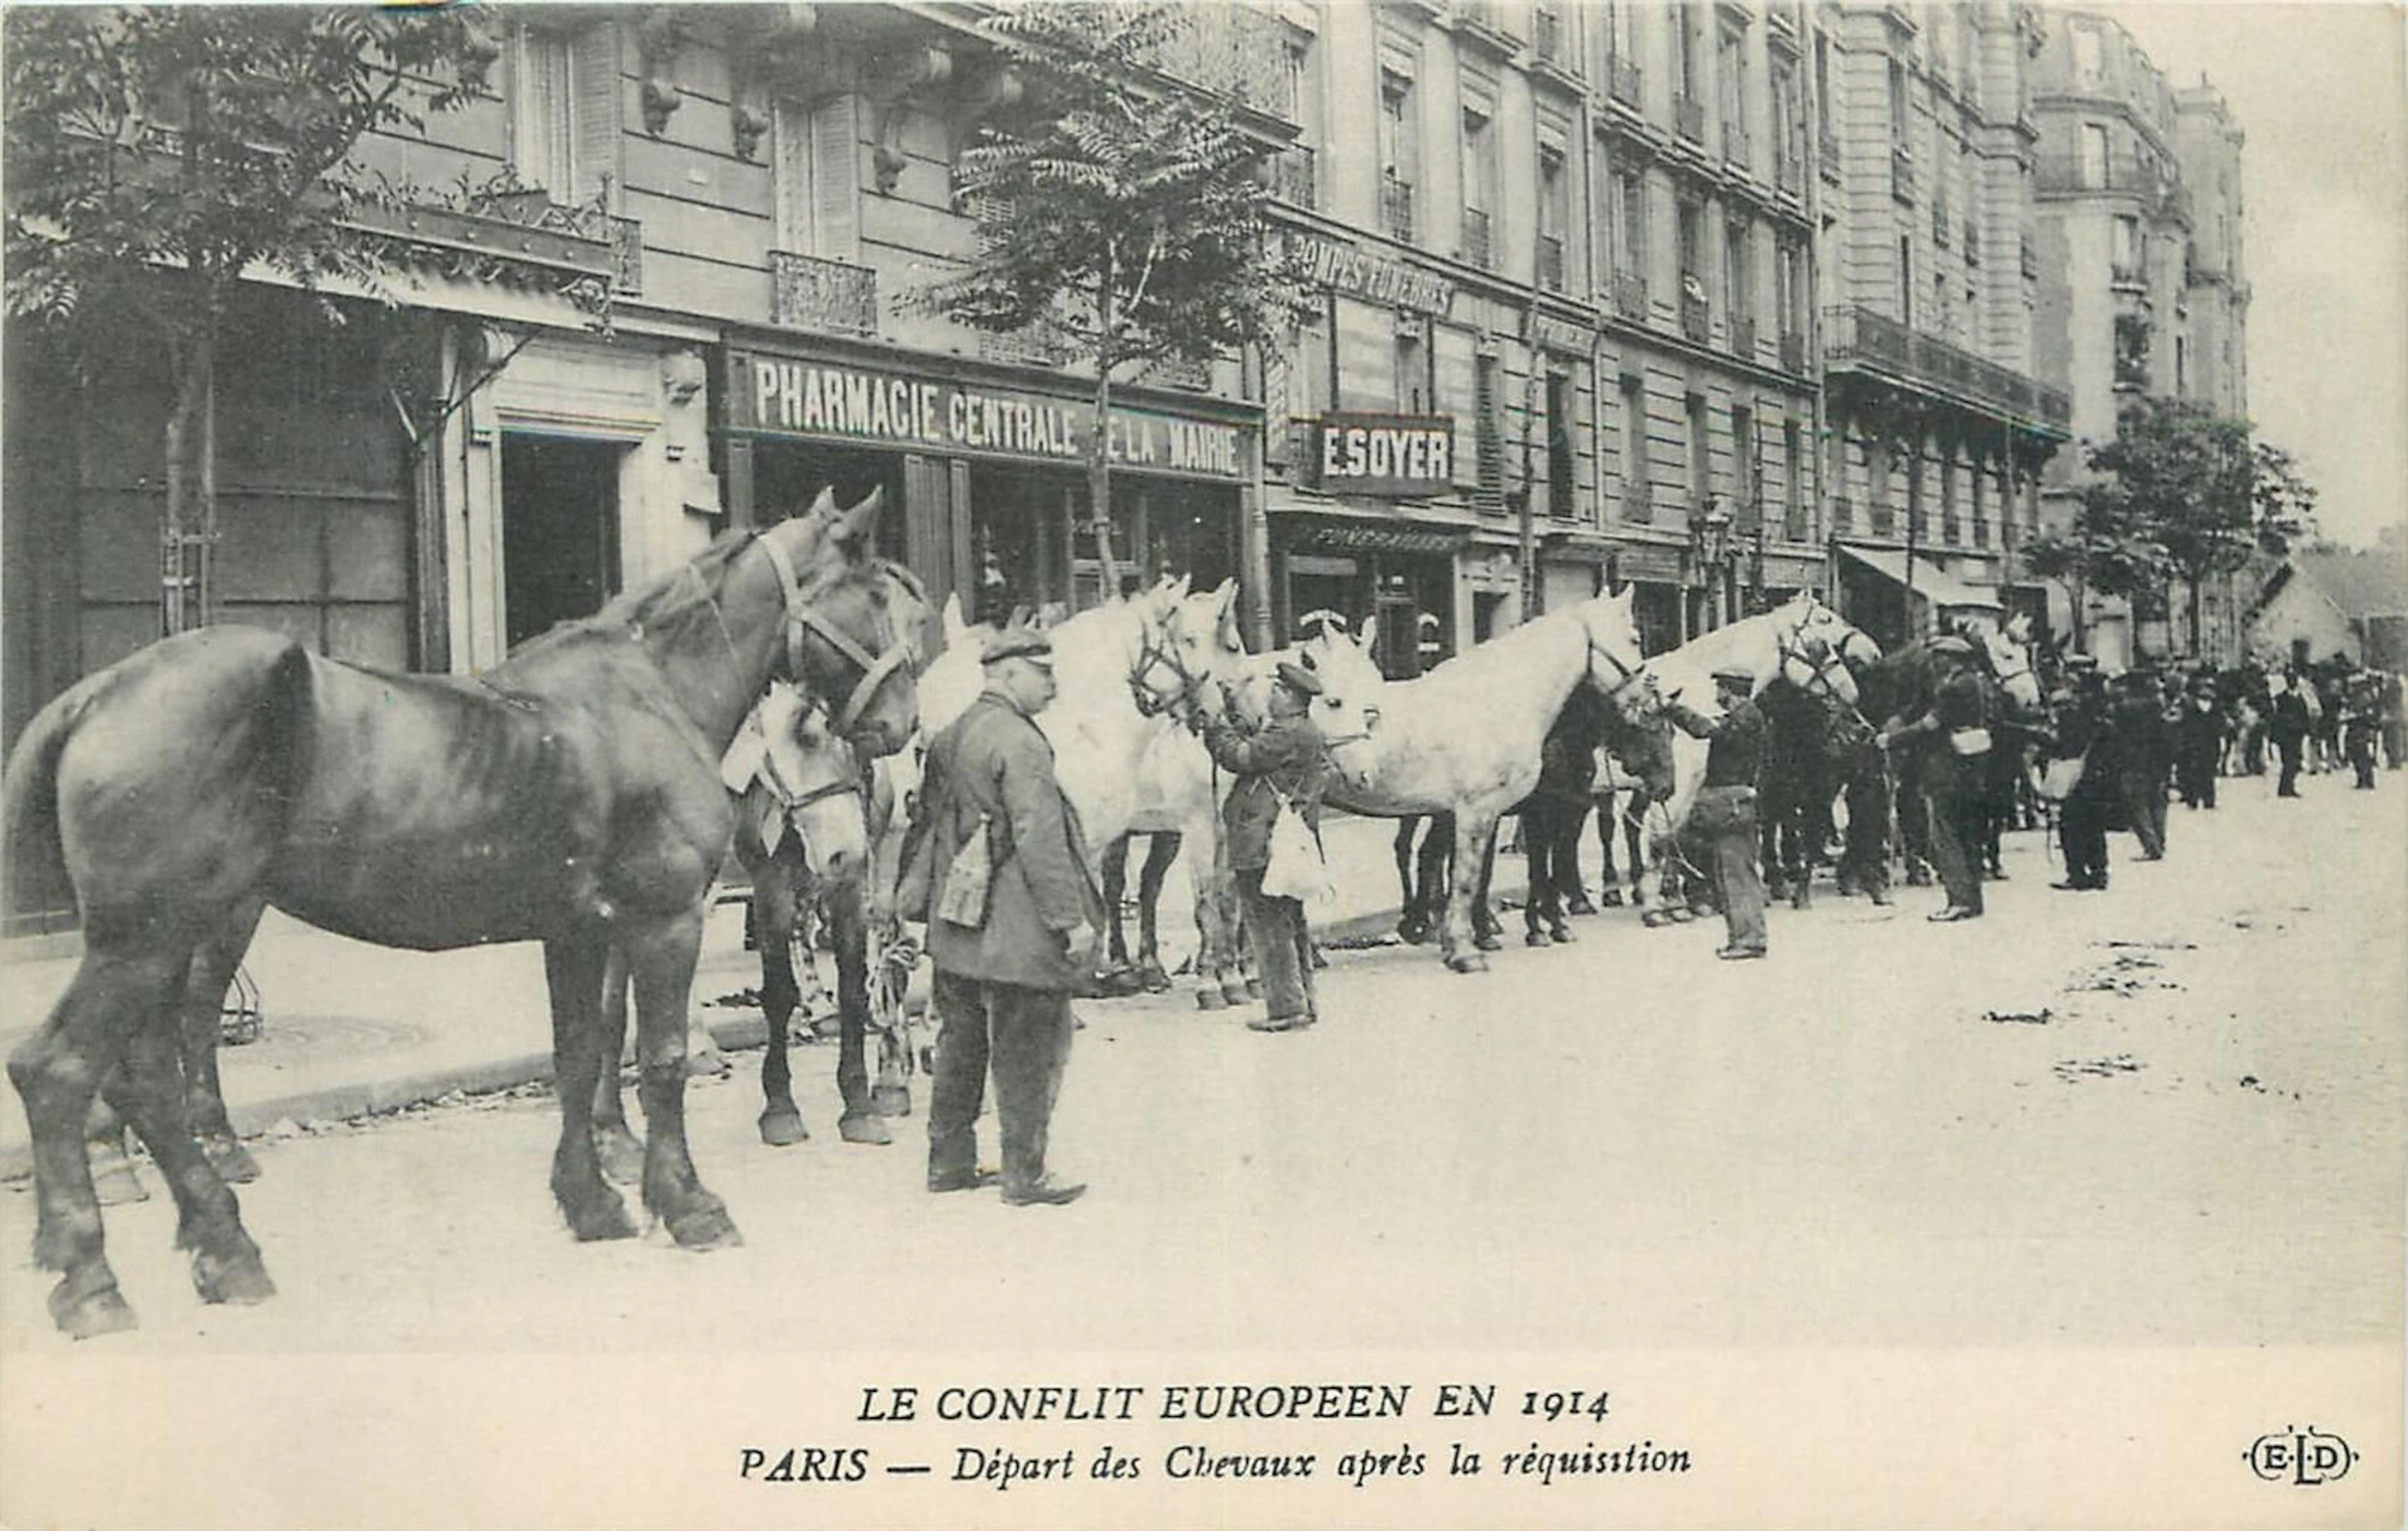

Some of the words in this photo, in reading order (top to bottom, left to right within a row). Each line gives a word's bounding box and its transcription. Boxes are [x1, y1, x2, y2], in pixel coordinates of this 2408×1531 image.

[756, 361, 941, 440] PHARMACIE
[949, 391, 1079, 455] CENTRALE
[1126, 416, 1156, 462] LA
[1170, 422, 1239, 474] MAIRIE
